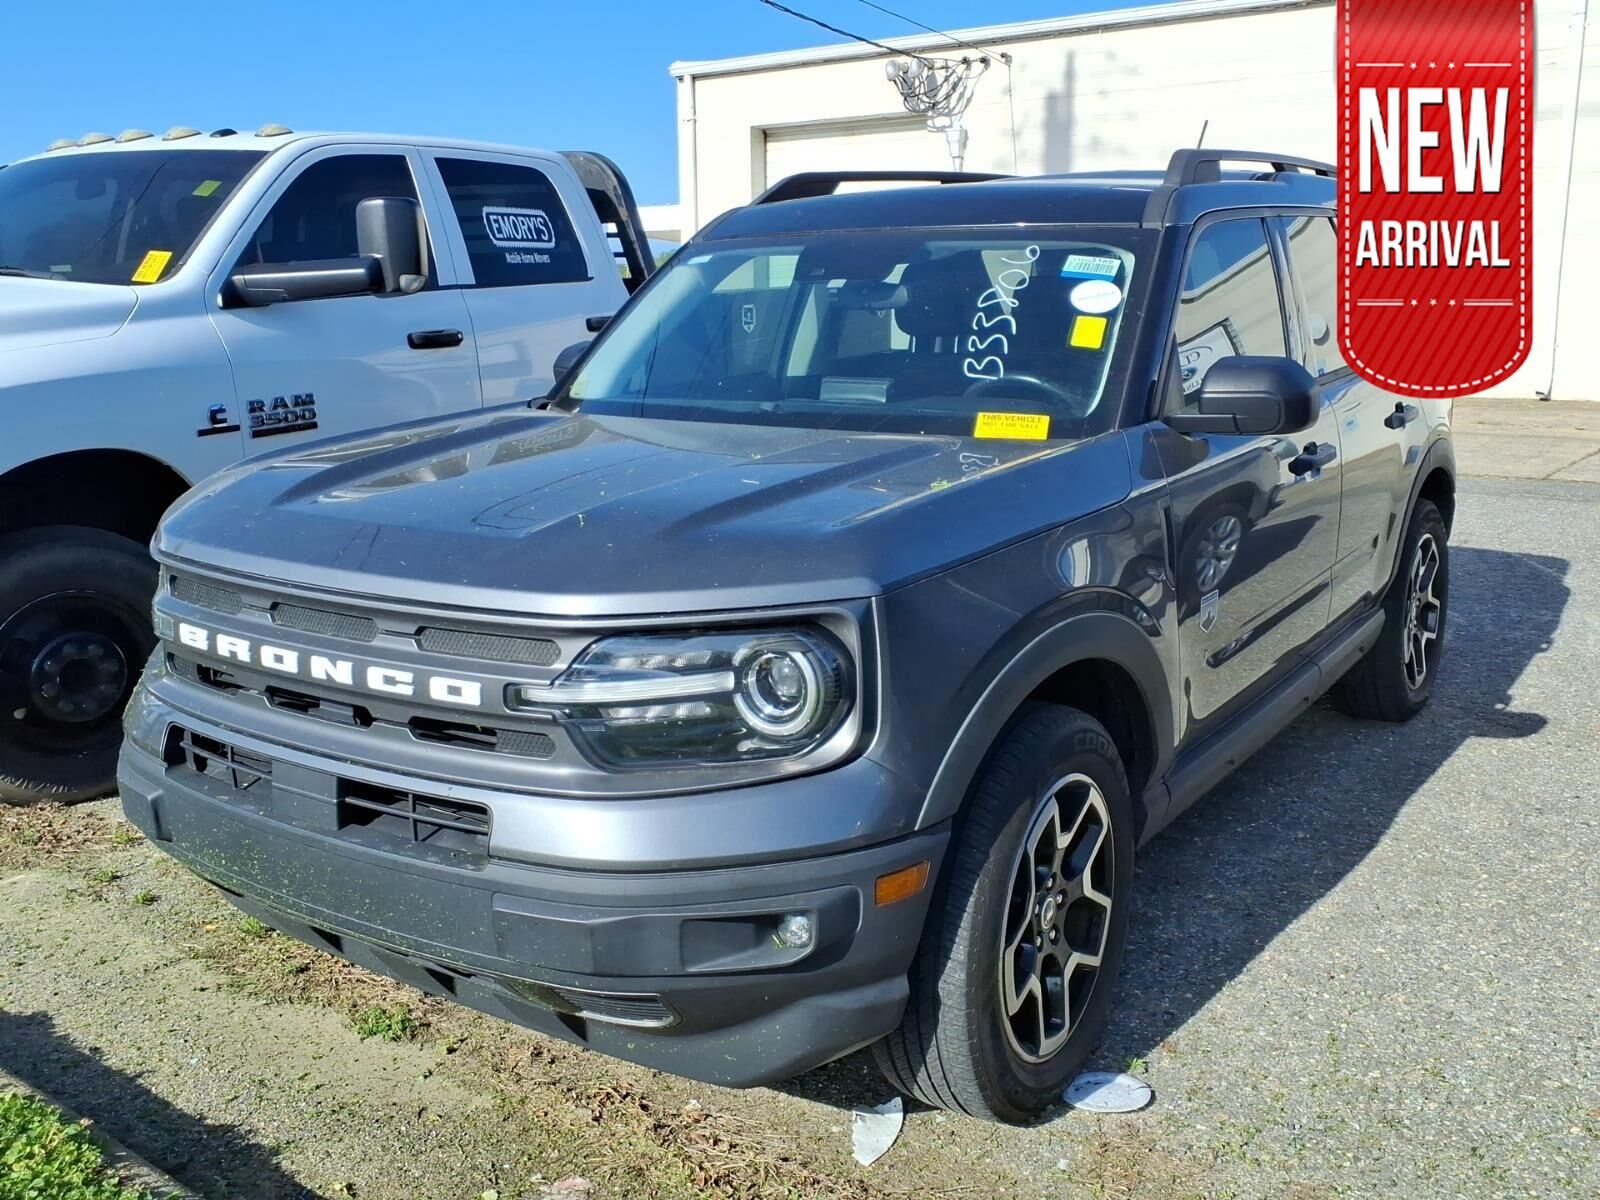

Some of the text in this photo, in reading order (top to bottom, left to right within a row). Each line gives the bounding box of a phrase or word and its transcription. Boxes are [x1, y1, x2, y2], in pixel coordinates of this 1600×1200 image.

[489, 215, 549, 241] EMORY'S
[248, 393, 316, 414] RAM
[249, 407, 317, 430] 3500
[1005, 415, 1043, 423] VEHICLE
[179, 623, 481, 706] BRONCO
